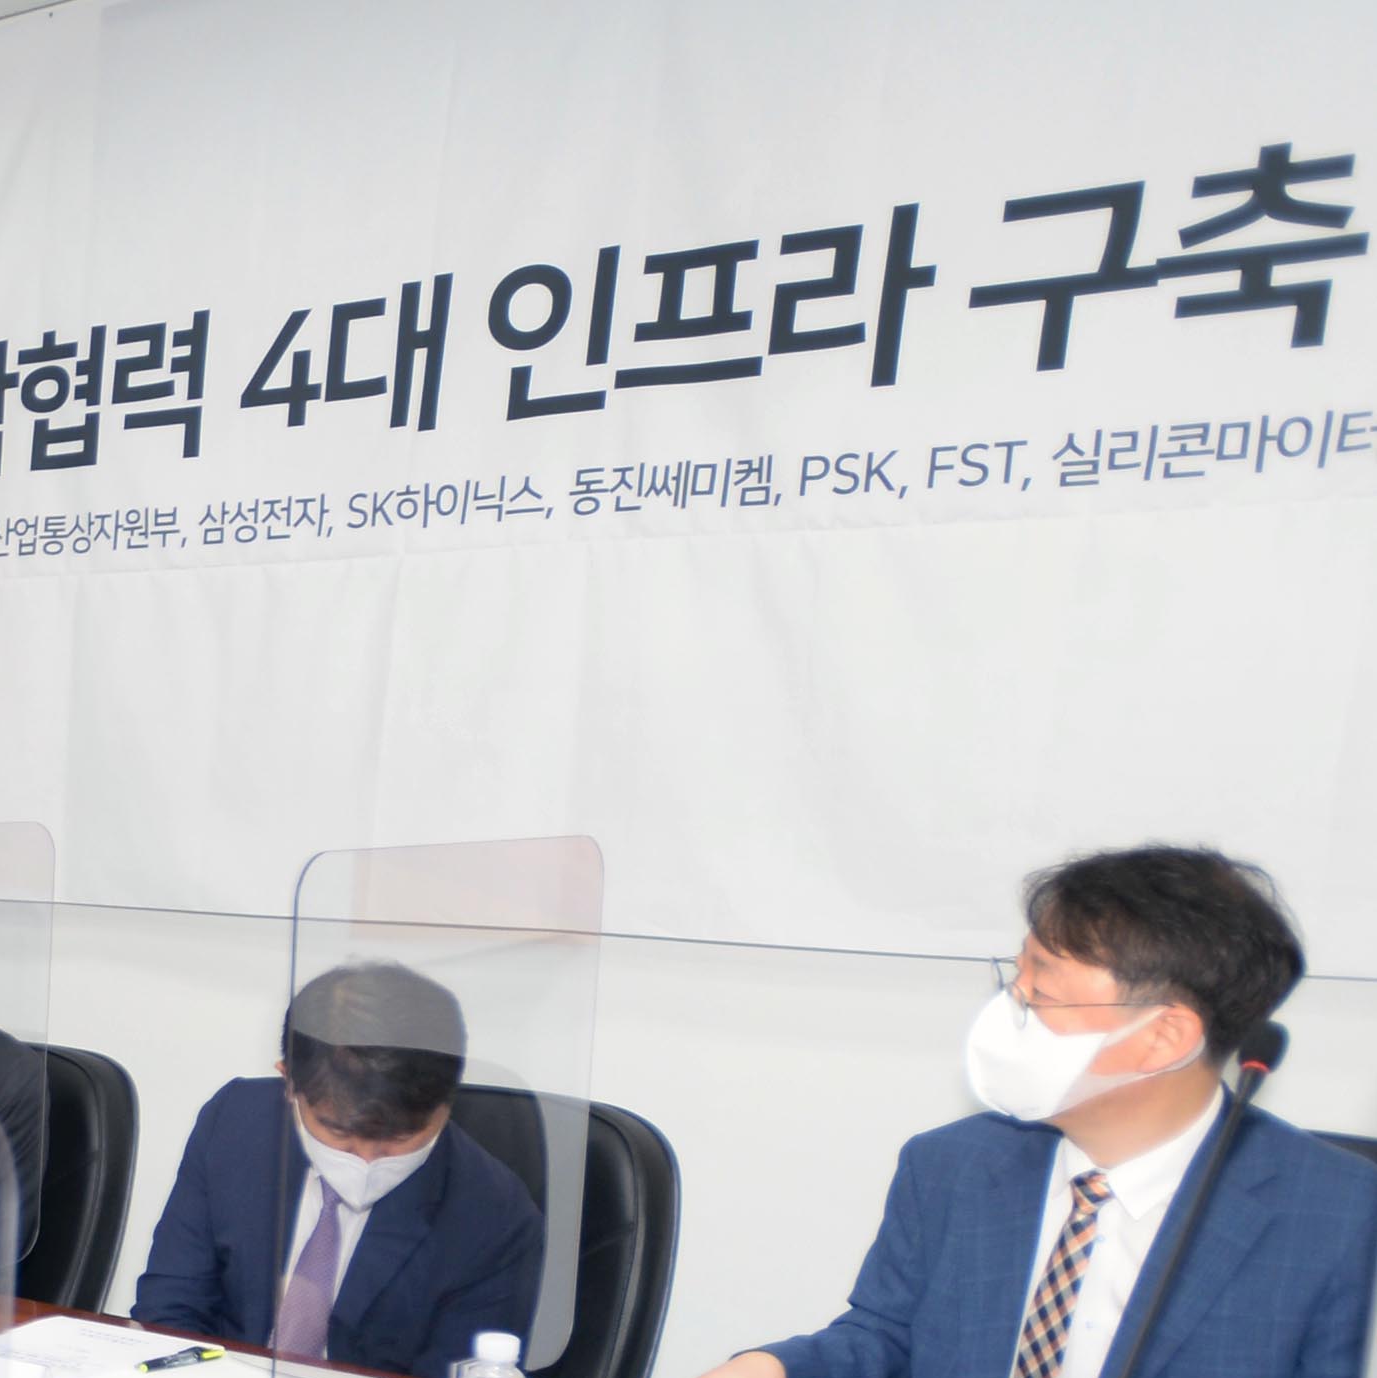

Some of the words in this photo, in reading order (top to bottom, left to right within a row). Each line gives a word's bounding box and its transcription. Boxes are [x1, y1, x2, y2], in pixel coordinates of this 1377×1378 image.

[239, 272, 454, 433] 4대
[487, 200, 938, 422] 인프라
[967, 140, 1371, 373] 구축
[197, 492, 334, 546] 삼성전자,
[346, 475, 554, 530] SK하이닉스,
[568, 453, 782, 517] 동진쎄미켐,
[798, 449, 909, 500] PSK,
[926, 439, 1032, 492] FST,
